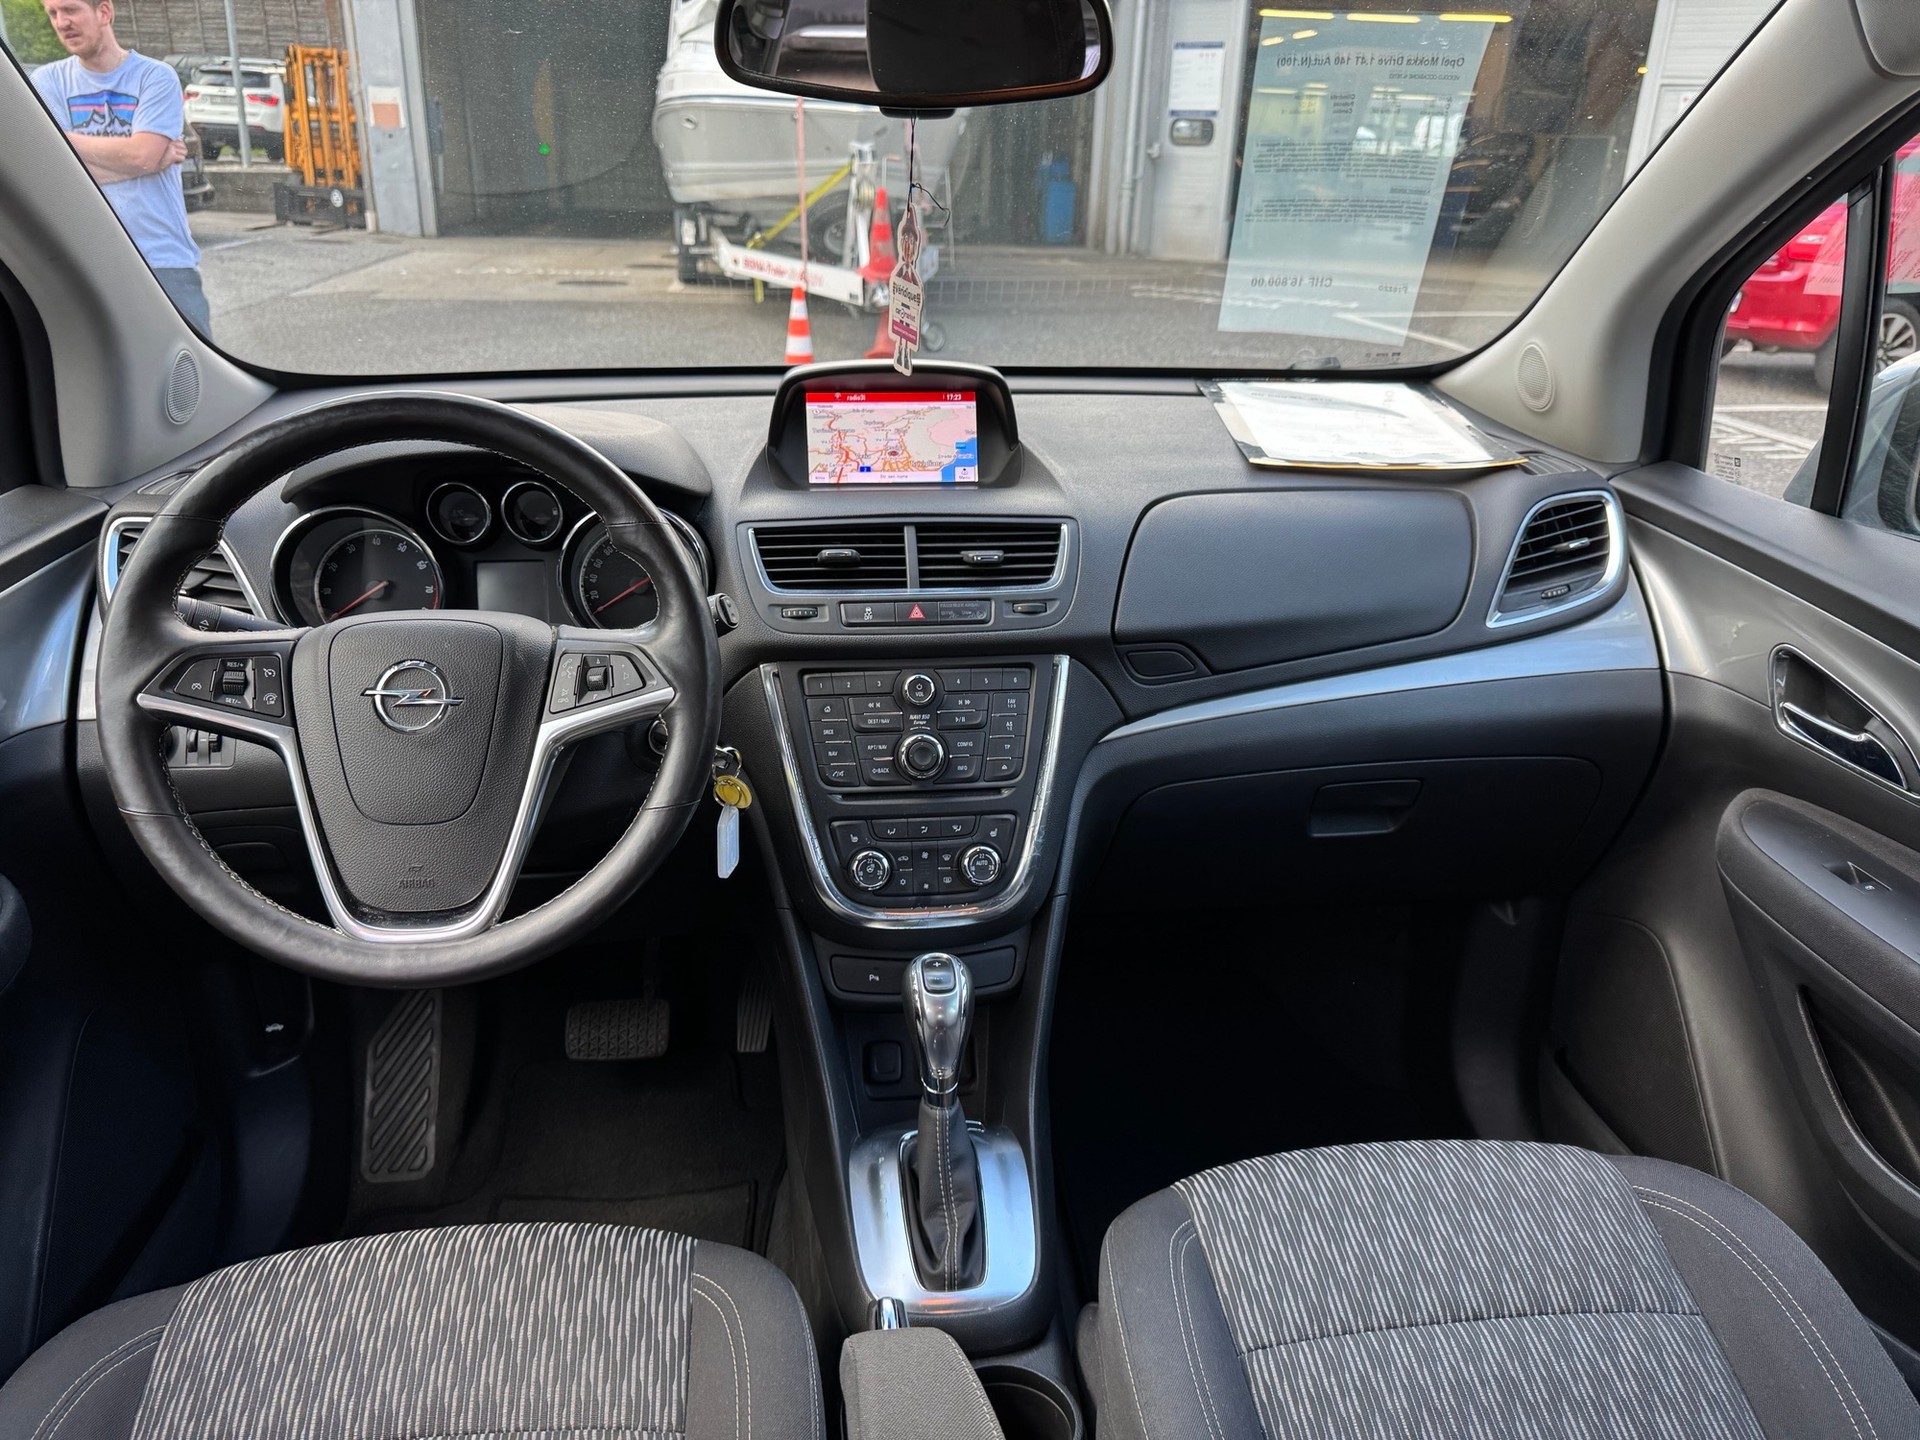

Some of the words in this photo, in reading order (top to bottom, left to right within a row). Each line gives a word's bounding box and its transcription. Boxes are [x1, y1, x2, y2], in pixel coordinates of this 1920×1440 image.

[372, 538, 381, 546] 40
[346, 544, 357, 554] 30
[397, 542, 408, 553] 50
[603, 546, 614, 556] 80
[328, 562, 339, 572] 20
[593, 558, 604, 569] 60
[589, 573, 598, 583] 40
[590, 590, 599, 600] 20
